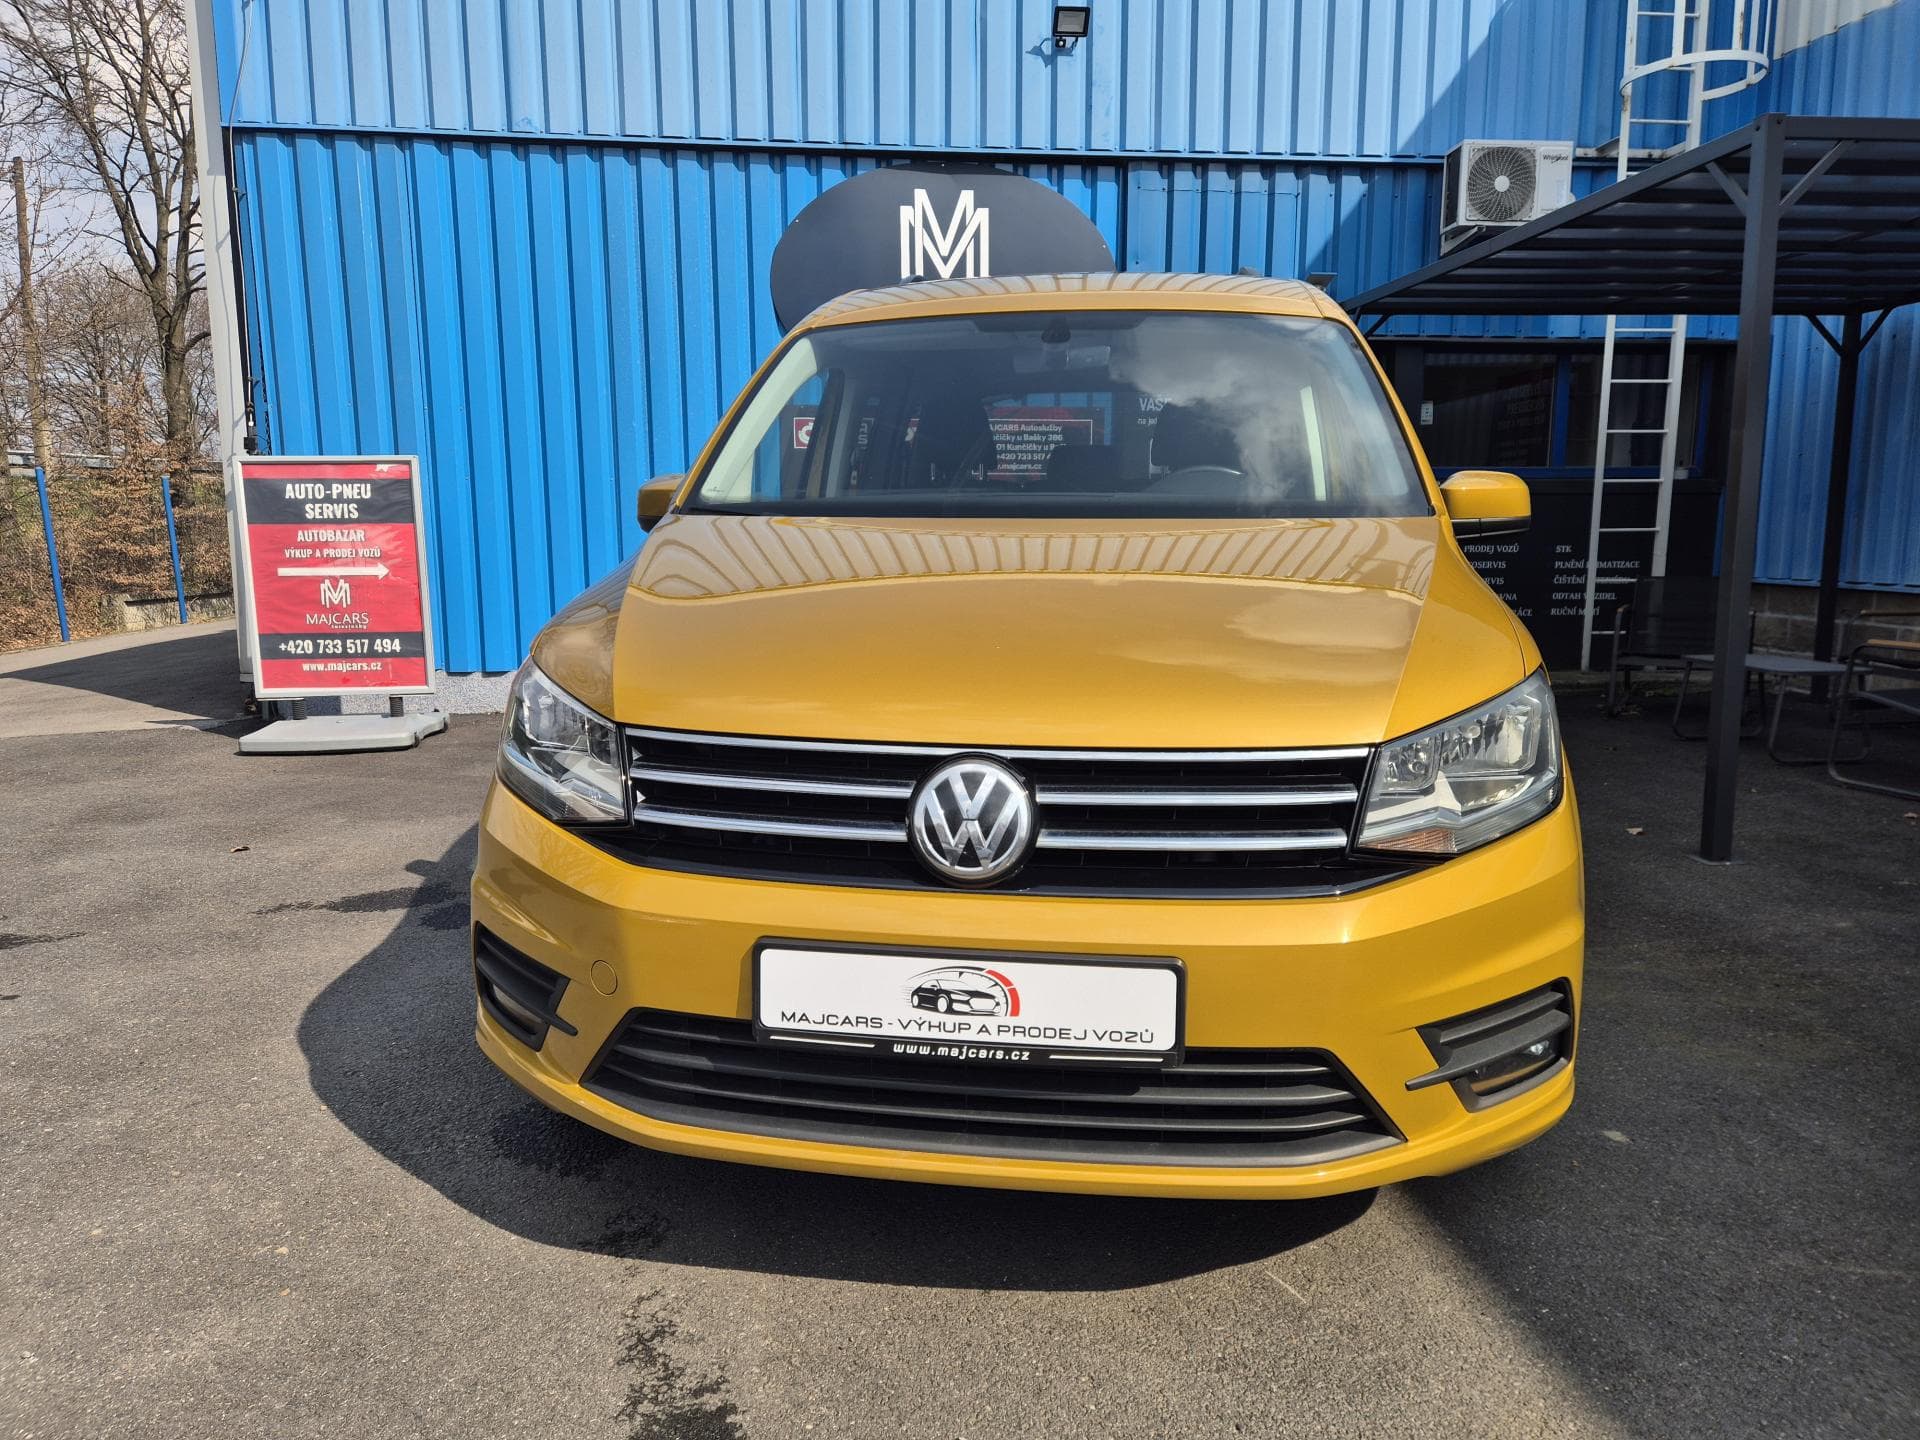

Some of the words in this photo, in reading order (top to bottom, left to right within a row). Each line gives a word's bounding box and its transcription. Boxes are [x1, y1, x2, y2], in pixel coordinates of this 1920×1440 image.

[285, 483, 372, 499] AUTO-PNEU
[305, 503, 359, 519] SERVIS
[297, 529, 366, 542] AUTOBAZAR
[285, 547, 313, 558] VÝKUP
[315, 549, 321, 558] A
[323, 548, 356, 558] PRODEJ
[1464, 544, 1495, 554] PRODEJ
[1497, 542, 1520, 553] VOZŮ
[1555, 545, 1573, 553] STK
[1471, 560, 1507, 569] OSERVIS
[1554, 559, 1584, 568] PLNĚNÍ
[1552, 592, 1581, 600] ODTAH
[1583, 592, 1617, 600] VZIDEL
[1550, 606, 1577, 616] RUČNÍ
[306, 612, 369, 625] MAJCARS
[279, 640, 313, 654] +420
[317, 639, 343, 654] 733
[346, 639, 370, 653] 517
[373, 638, 401, 653] 494
[302, 661, 383, 673] www.majcars.cz
[781, 1011, 883, 1029] MAJCARS
[976, 1023, 992, 1036] A
[998, 1025, 1087, 1040] PRODEJ
[1092, 1028, 1154, 1044] VOZŮ
[893, 1043, 1030, 1061] www.majcars.cz
